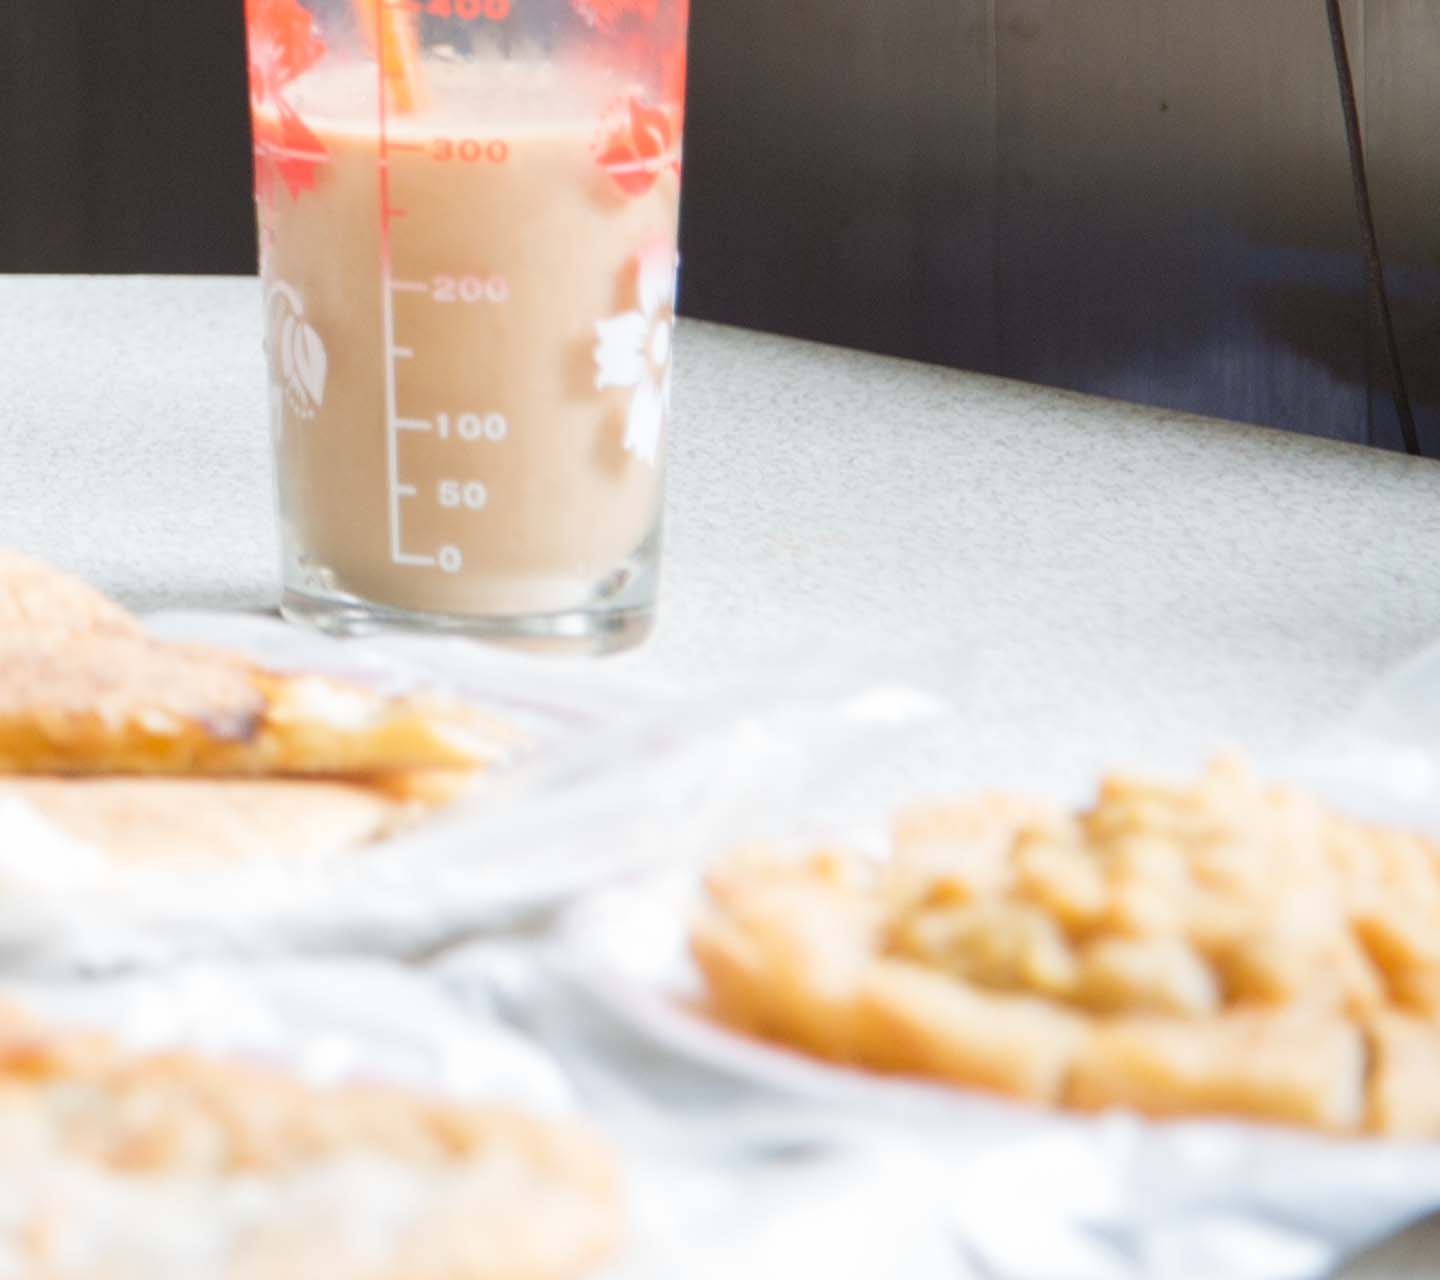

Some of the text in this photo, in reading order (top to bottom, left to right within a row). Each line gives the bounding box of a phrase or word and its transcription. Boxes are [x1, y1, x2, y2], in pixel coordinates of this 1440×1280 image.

[431, 138, 510, 164] 300
[432, 273, 510, 303] 200
[436, 411, 508, 441] 100
[437, 479, 488, 510] 50
[437, 544, 464, 574] 0
